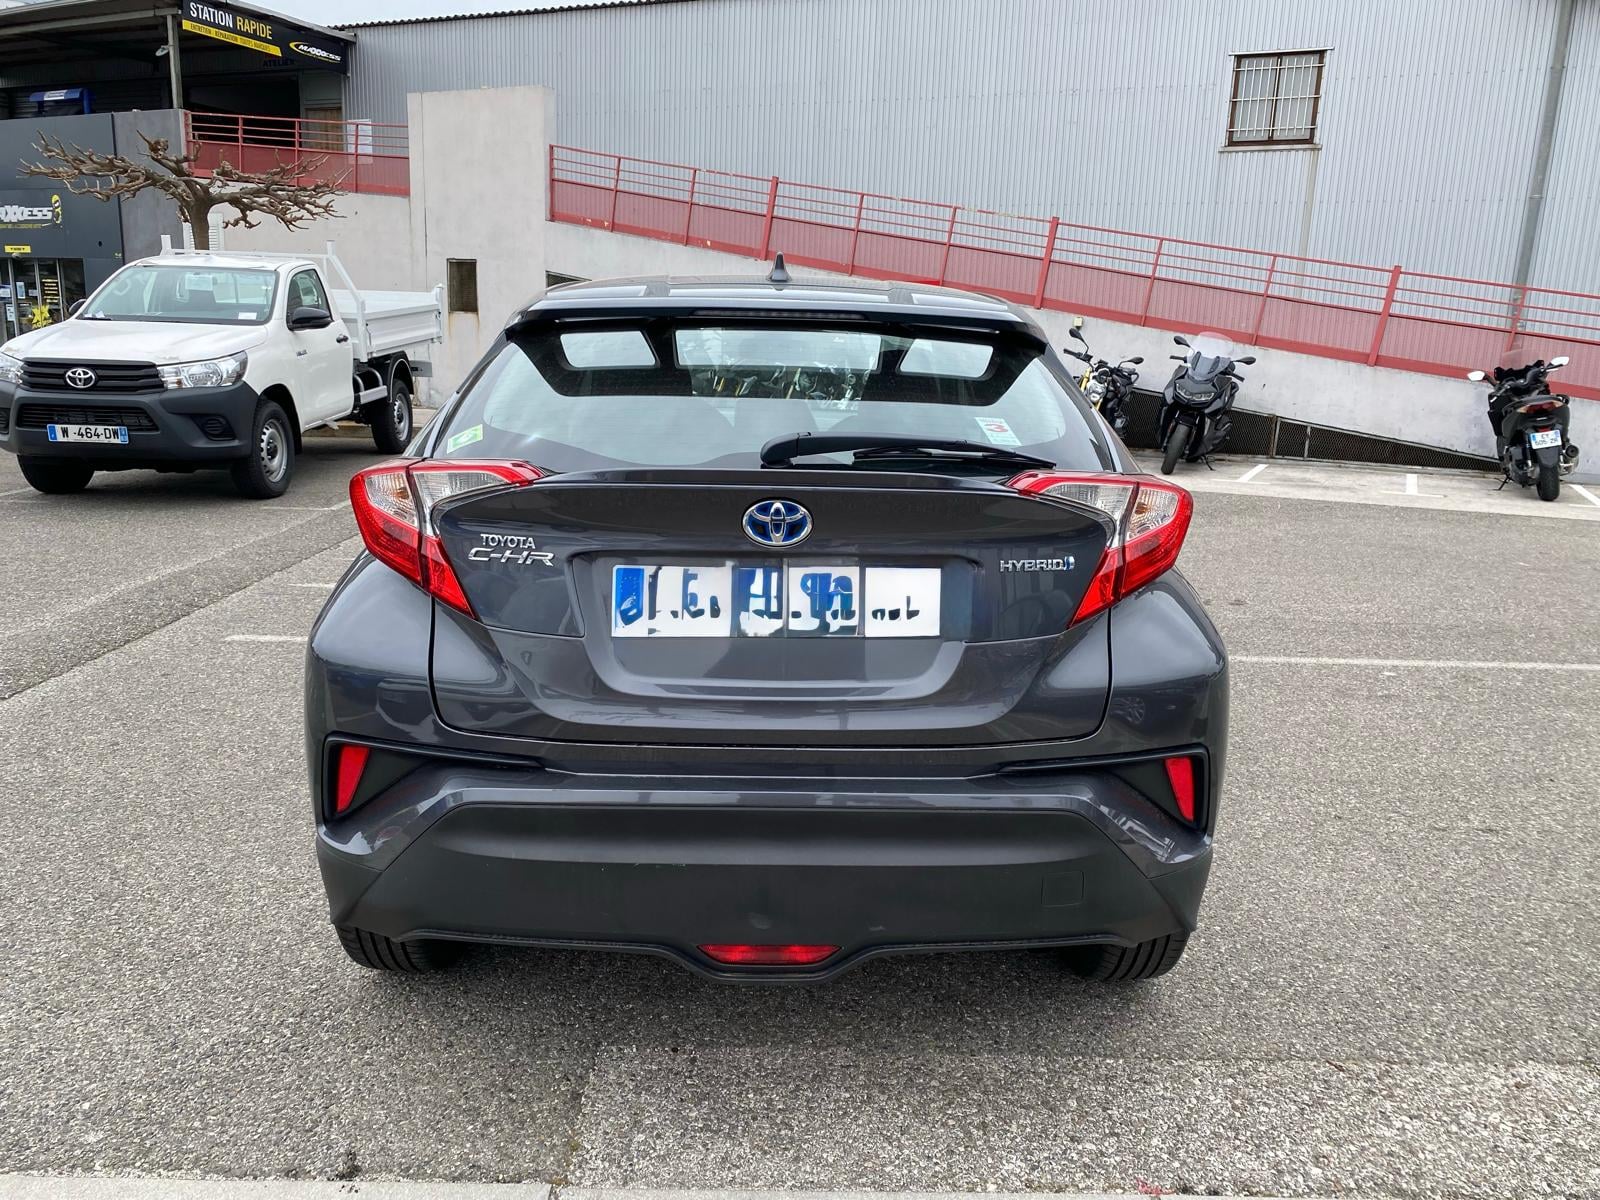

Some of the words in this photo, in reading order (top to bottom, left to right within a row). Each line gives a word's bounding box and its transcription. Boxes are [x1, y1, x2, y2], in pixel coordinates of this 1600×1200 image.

[190, 2, 233, 28] STATION
[236, 16, 273, 40] RAPIDE
[480, 533, 536, 549] TOYOTA
[468, 547, 554, 567] C-HR
[1000, 559, 1064, 572] HYBRID
